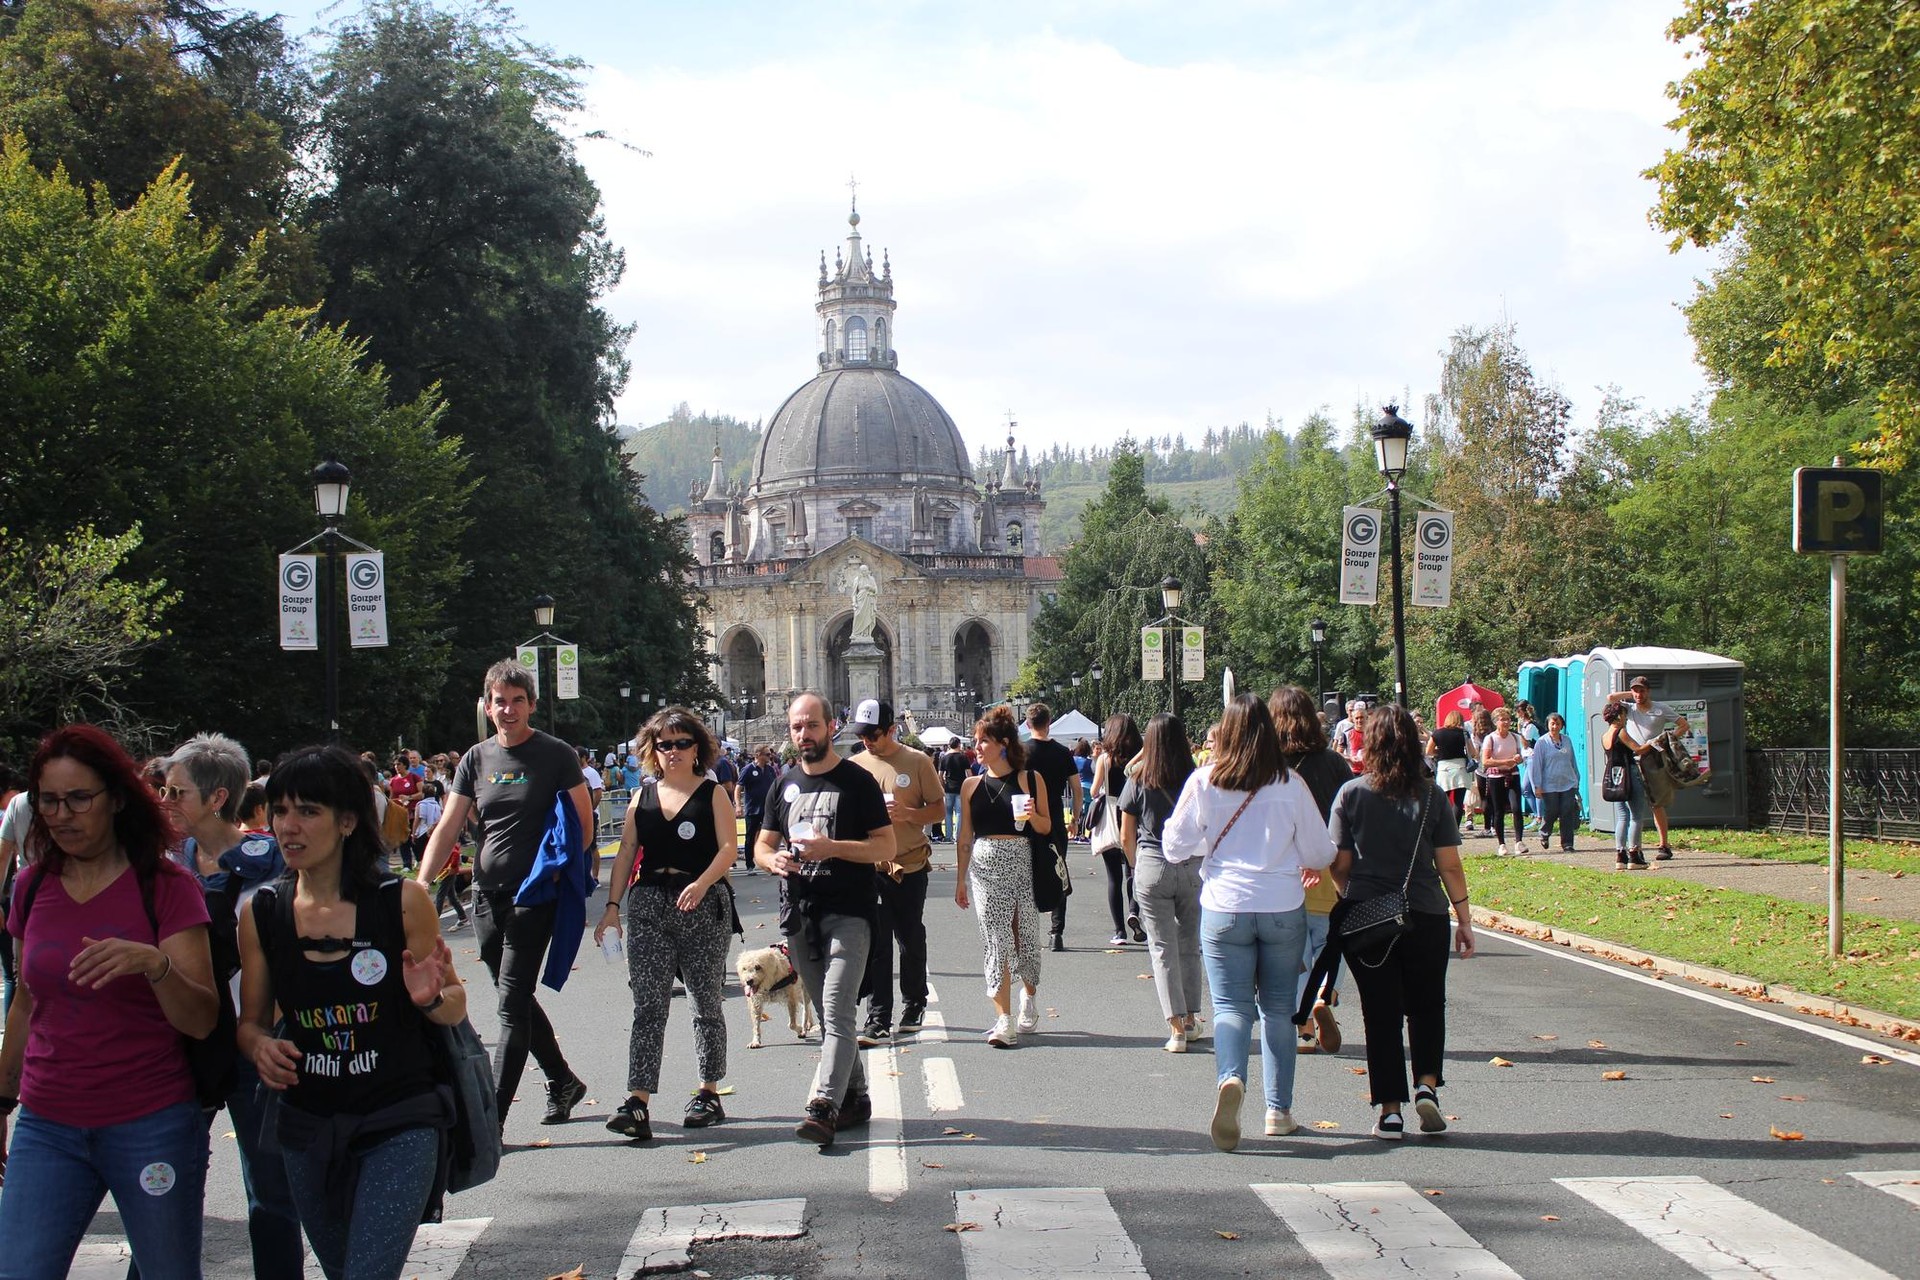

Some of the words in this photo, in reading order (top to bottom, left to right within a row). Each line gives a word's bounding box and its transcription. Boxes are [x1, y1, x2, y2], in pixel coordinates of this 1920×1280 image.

[1818, 480, 1865, 541] P
[1350, 517, 1374, 542] G
[1423, 521, 1446, 546] G
[1345, 548, 1376, 559] Goizper
[1418, 552, 1449, 563] Goizper
[1344, 558, 1370, 569] Group
[1417, 562, 1443, 572] Group
[285, 564, 309, 588] G
[353, 563, 377, 587] G
[282, 595, 313, 605] Goizper
[350, 594, 382, 604] Goizper
[282, 605, 307, 614] Group
[351, 603, 377, 613] Group
[295, 1002, 379, 1028] uskaraz
[322, 1030, 355, 1052] bizi
[305, 1052, 341, 1077] nahi
[349, 1050, 379, 1075] dut
